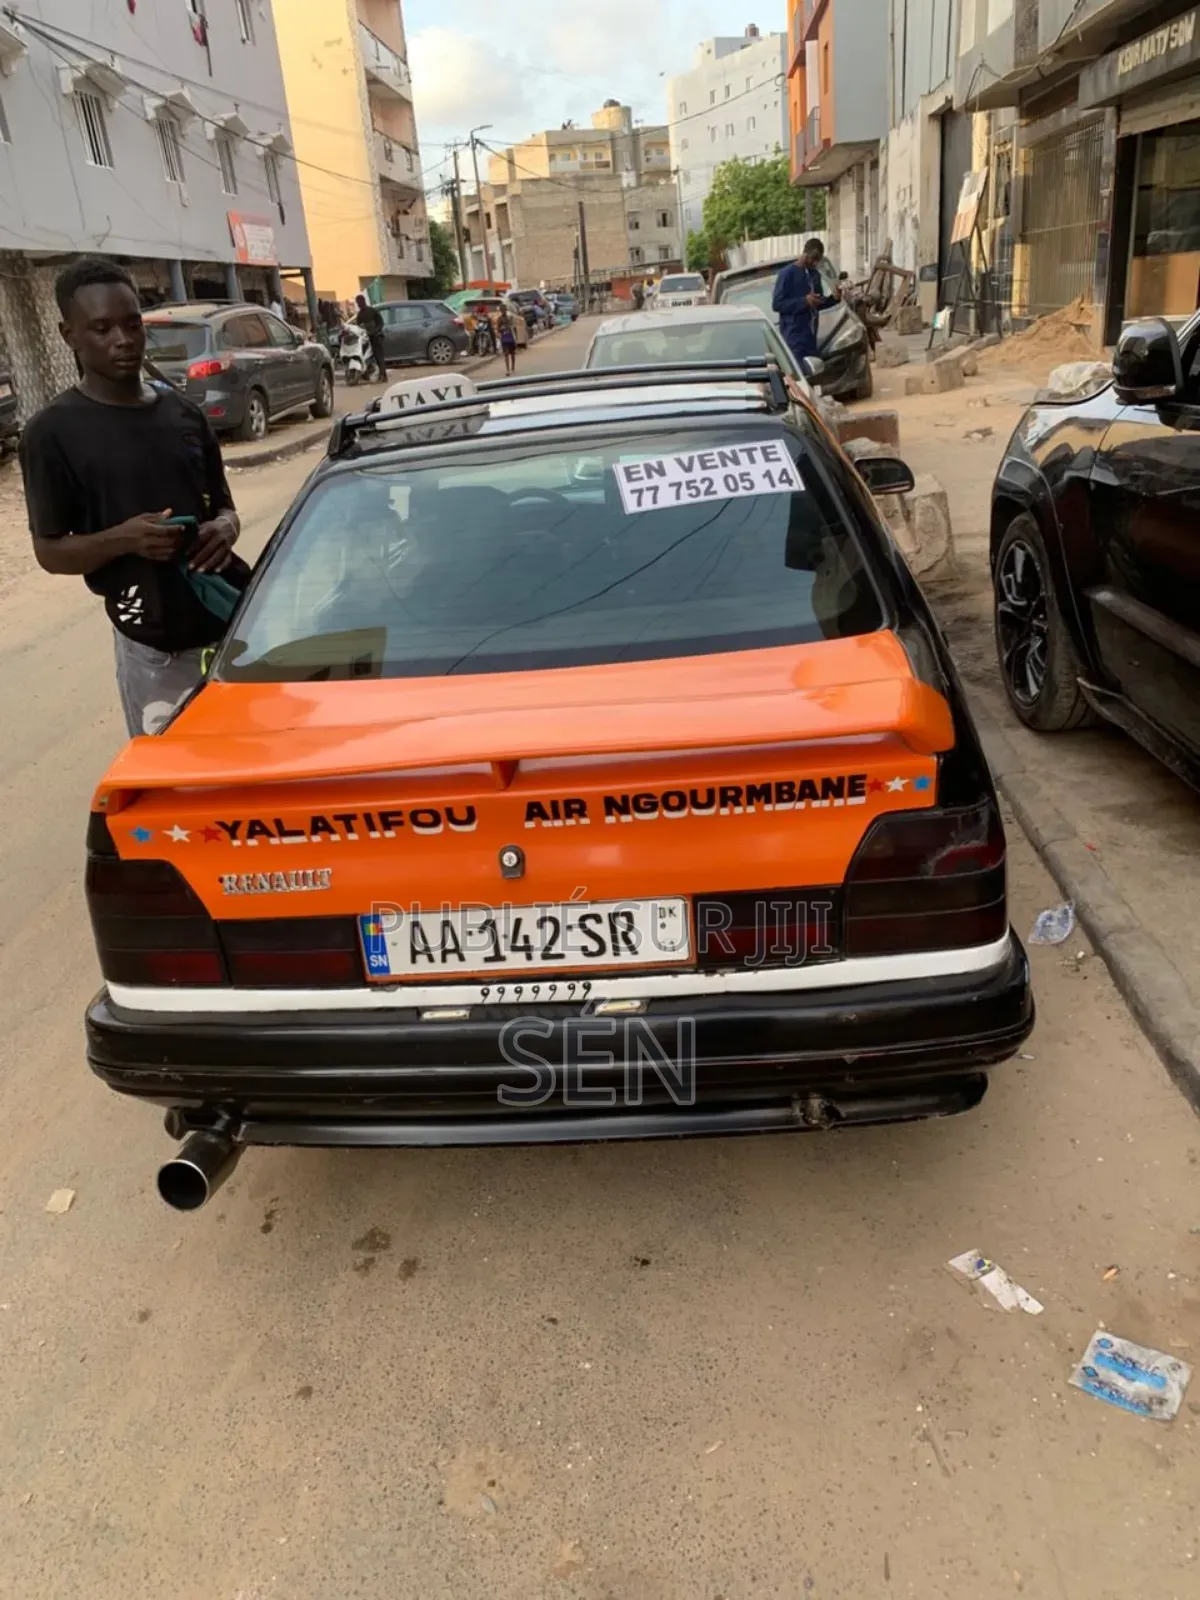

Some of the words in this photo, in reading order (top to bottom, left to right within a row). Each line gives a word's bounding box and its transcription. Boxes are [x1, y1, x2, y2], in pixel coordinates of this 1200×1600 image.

[1169, 11, 1196, 50] SOW
[623, 460, 667, 483] EN
[674, 444, 782, 474] VENTE
[630, 485, 660, 508] 77
[668, 477, 718, 501] 752
[723, 472, 756, 493] 05
[762, 467, 794, 489] 14
[215, 805, 478, 847] YALATIFOU
[524, 798, 590, 828] AIR
[603, 774, 868, 824] NGOURMBANE
[222, 868, 332, 895] RENAULT
[370, 954, 389, 968] SN
